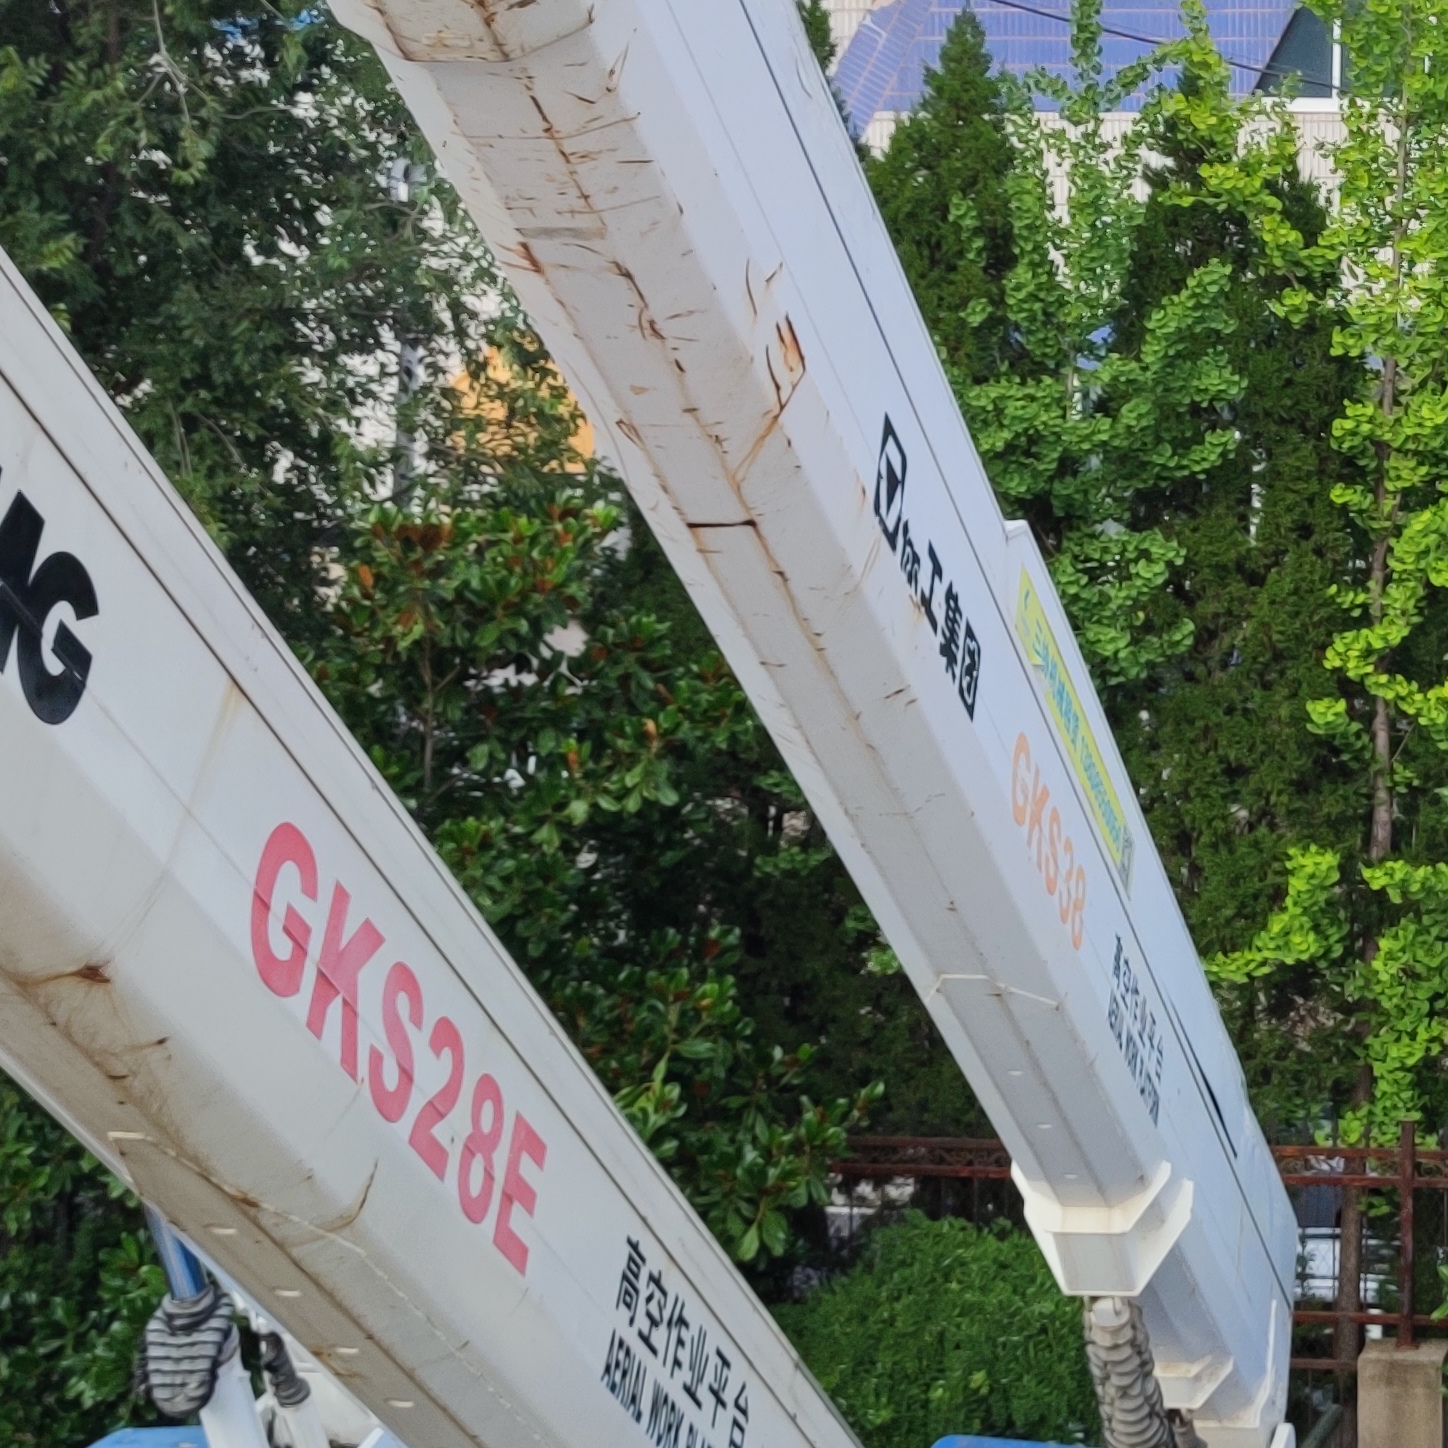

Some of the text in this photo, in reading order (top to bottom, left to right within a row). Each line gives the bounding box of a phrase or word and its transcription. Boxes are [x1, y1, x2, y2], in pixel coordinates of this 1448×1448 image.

[1012, 732, 1086, 951] GKS38
[250, 822, 548, 1278] GKS28E
[600, 1327, 647, 1425] AERIAL
